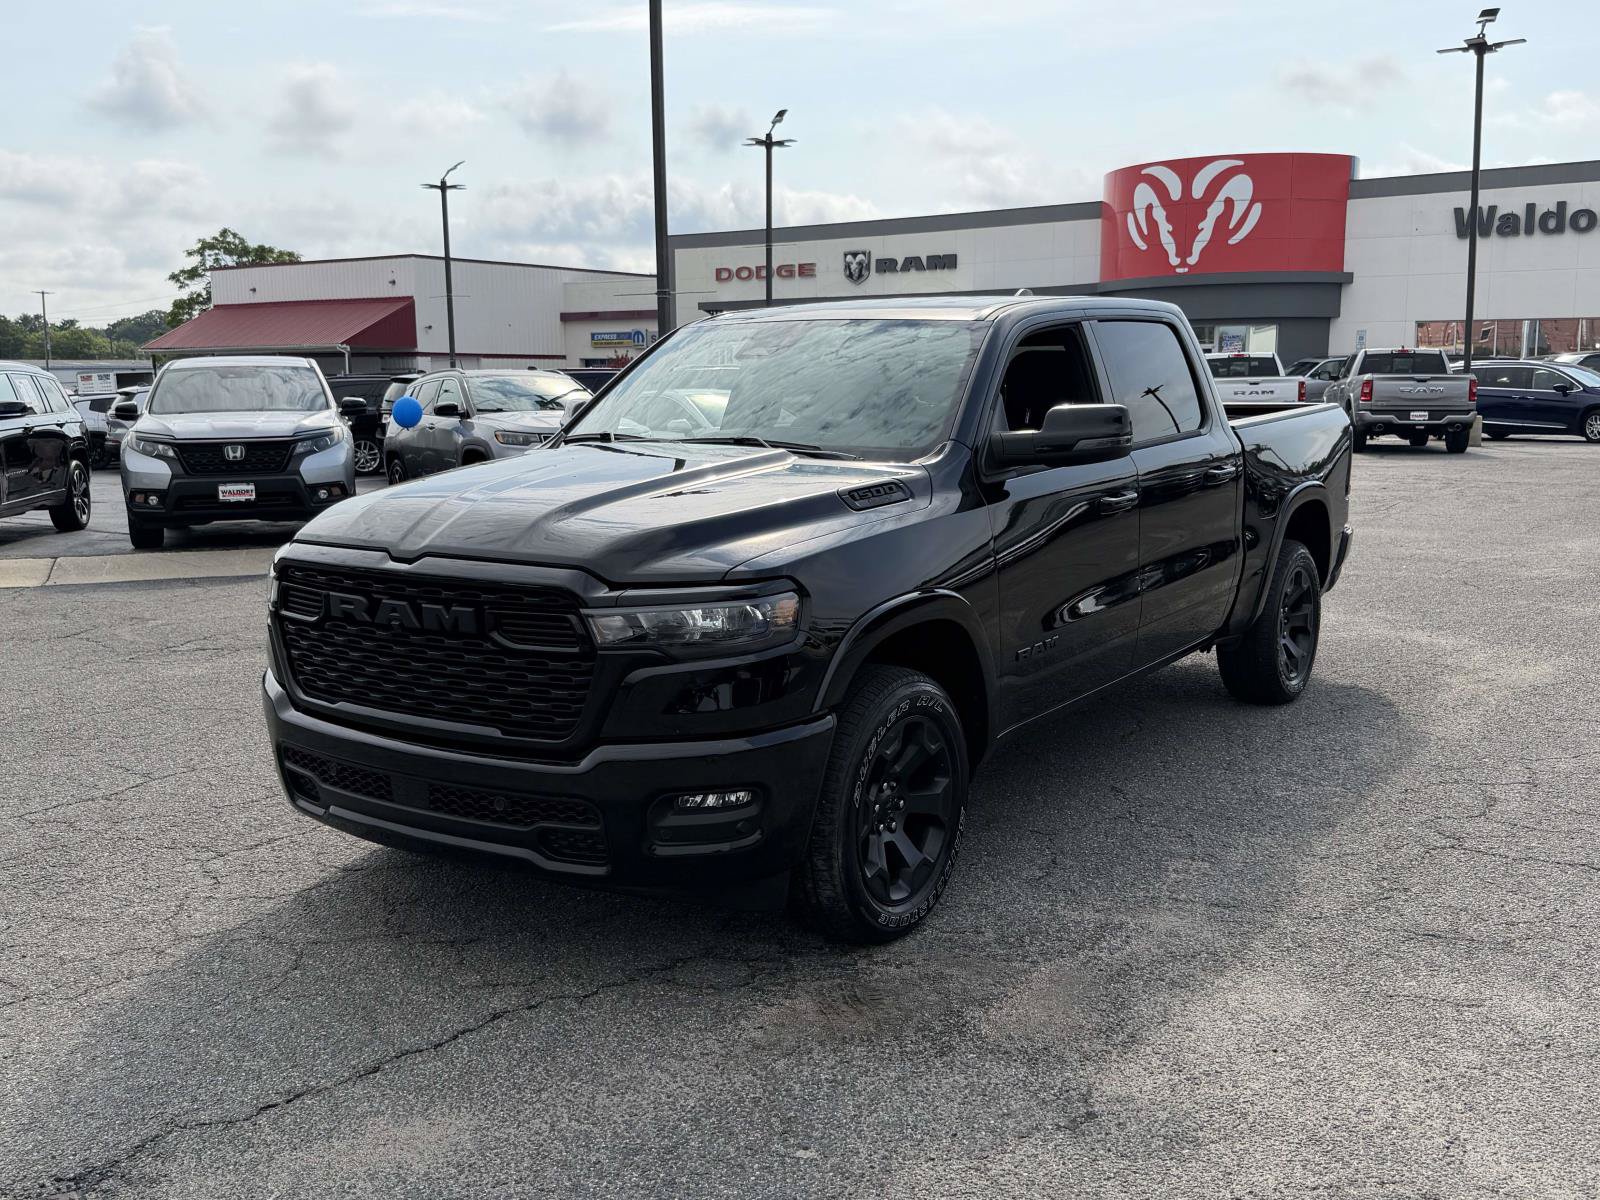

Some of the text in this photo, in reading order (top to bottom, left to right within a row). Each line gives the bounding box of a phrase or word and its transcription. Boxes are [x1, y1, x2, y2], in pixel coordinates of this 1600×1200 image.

[1453, 200, 1598, 239] Waldo
[715, 262, 817, 283] DODGE
[875, 253, 958, 273] RAM
[848, 482, 897, 501] 1500
[321, 591, 480, 635] RAM
